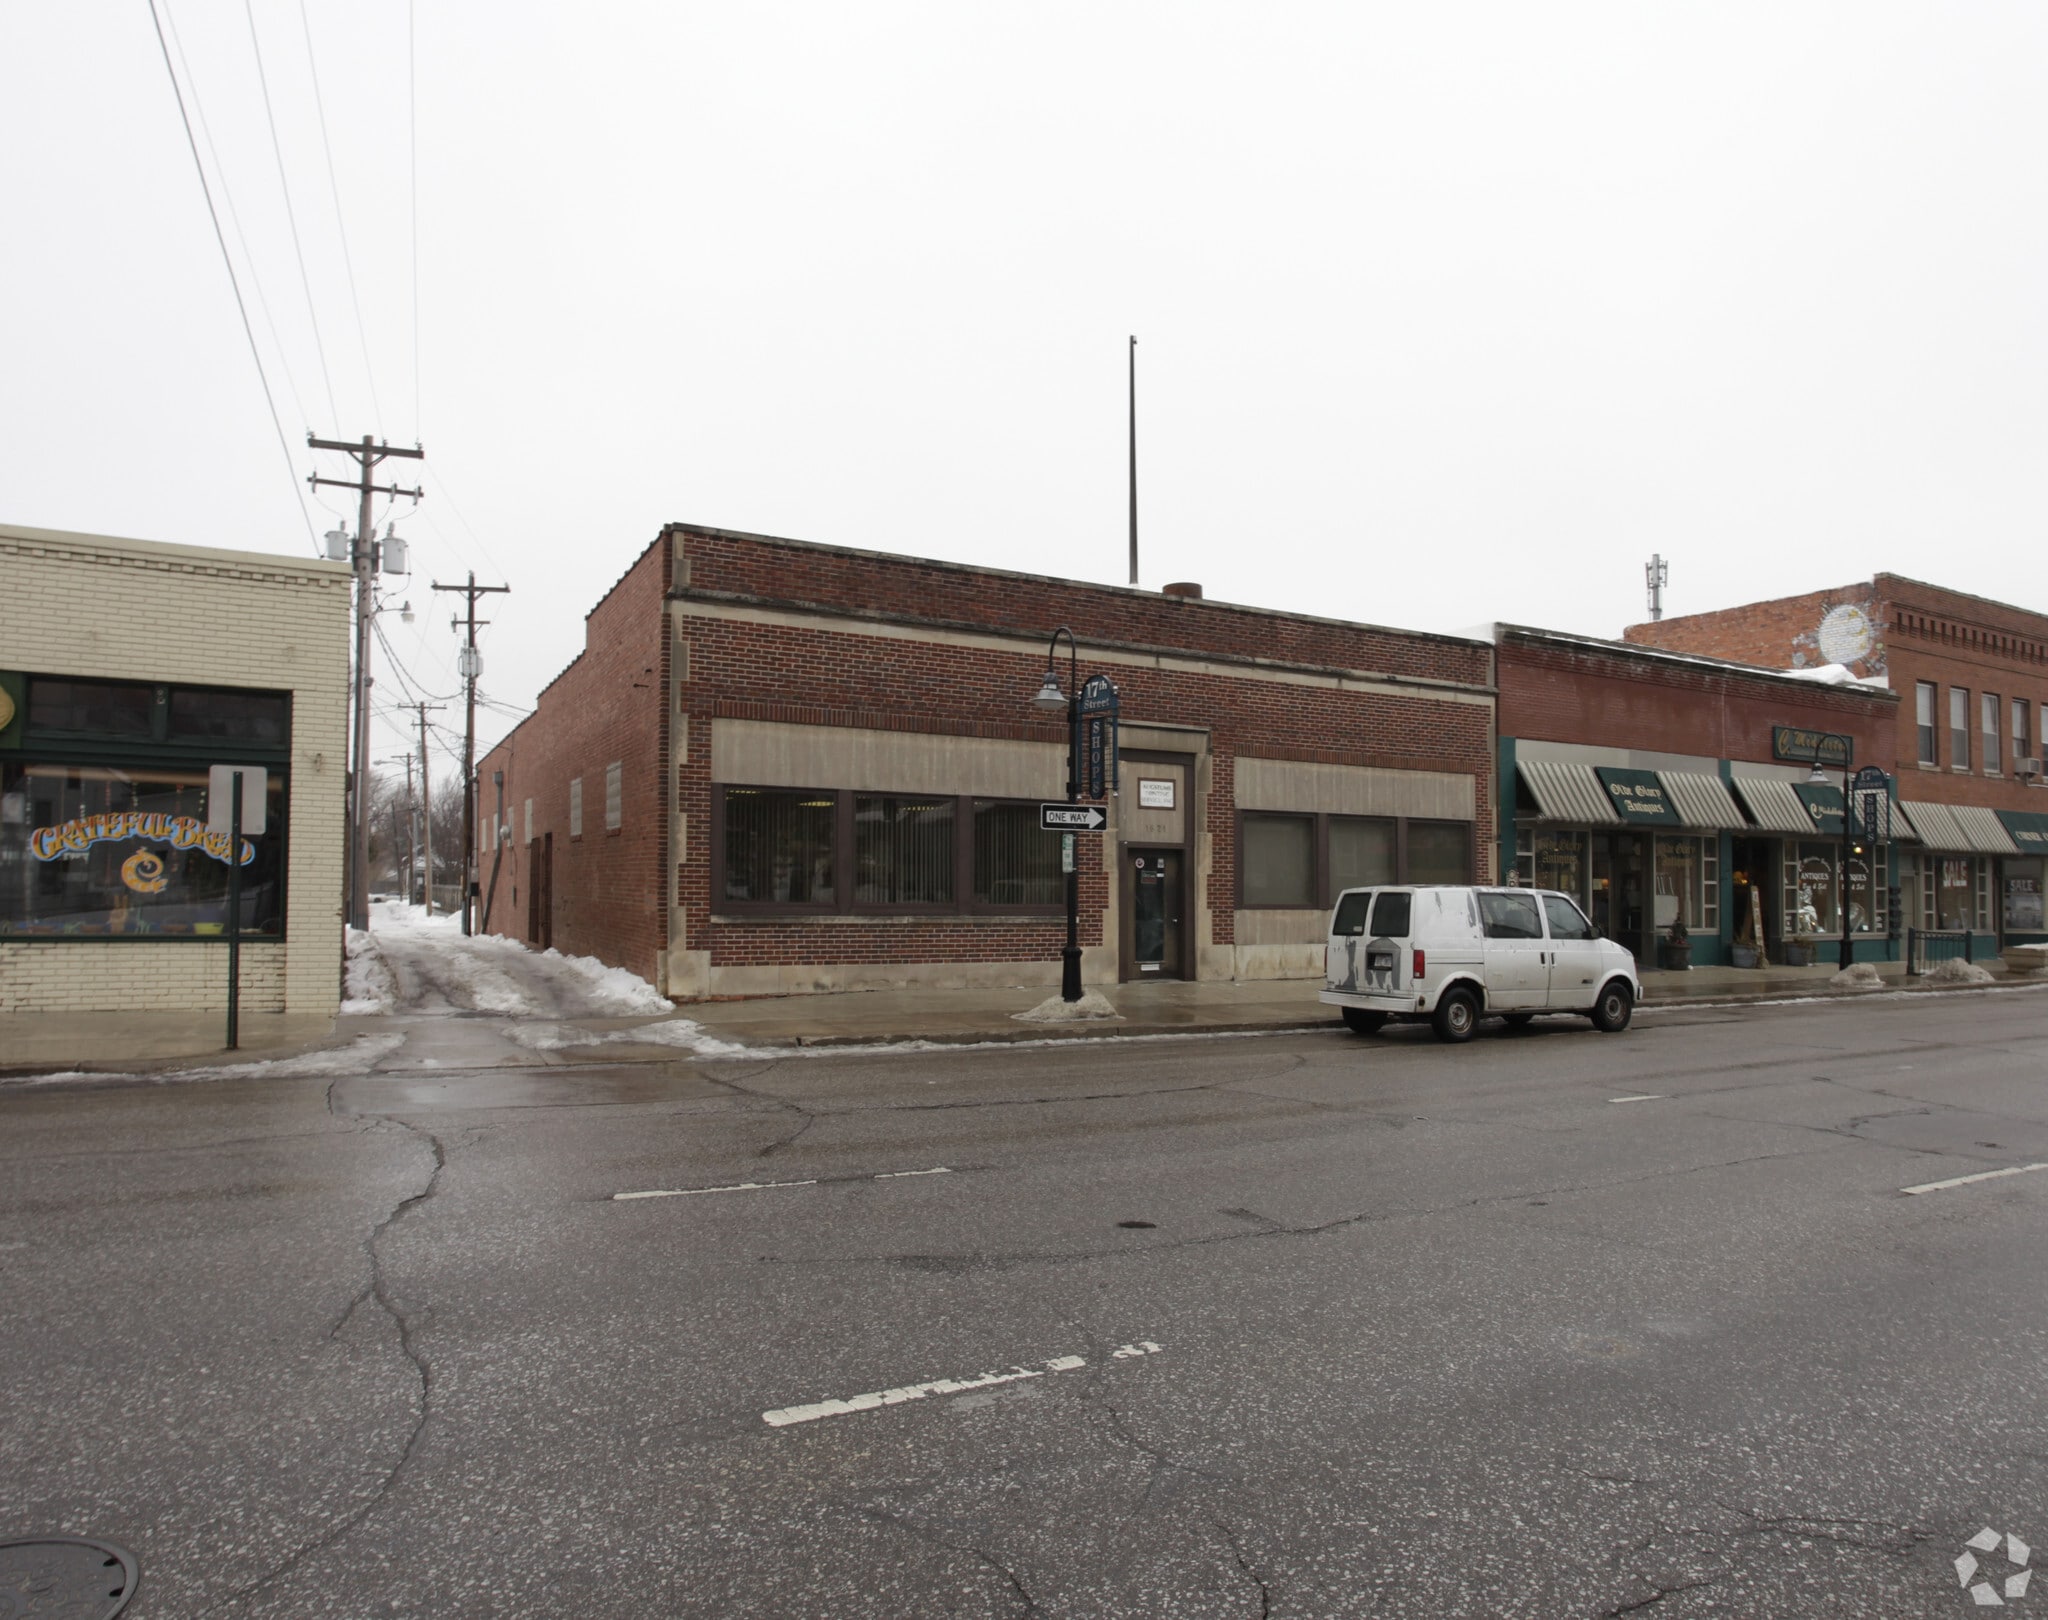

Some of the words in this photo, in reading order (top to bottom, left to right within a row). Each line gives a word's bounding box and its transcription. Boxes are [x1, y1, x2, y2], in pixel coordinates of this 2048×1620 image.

[1086, 681, 1107, 699] 17th
[1084, 698, 1110, 710] Street
[1091, 721, 1101, 793] SHOPS
[1624, 799, 1665, 815] Antiques
[1048, 811, 1066, 822] ONE
[1070, 813, 1088, 823] WAY
[1866, 796, 1875, 842] SHOPS
[31, 811, 172, 862] GRATEFUL
[1801, 872, 1829, 881] ANTIQUES
[1943, 861, 1967, 887] SALE
[2010, 879, 2034, 892] SALE
